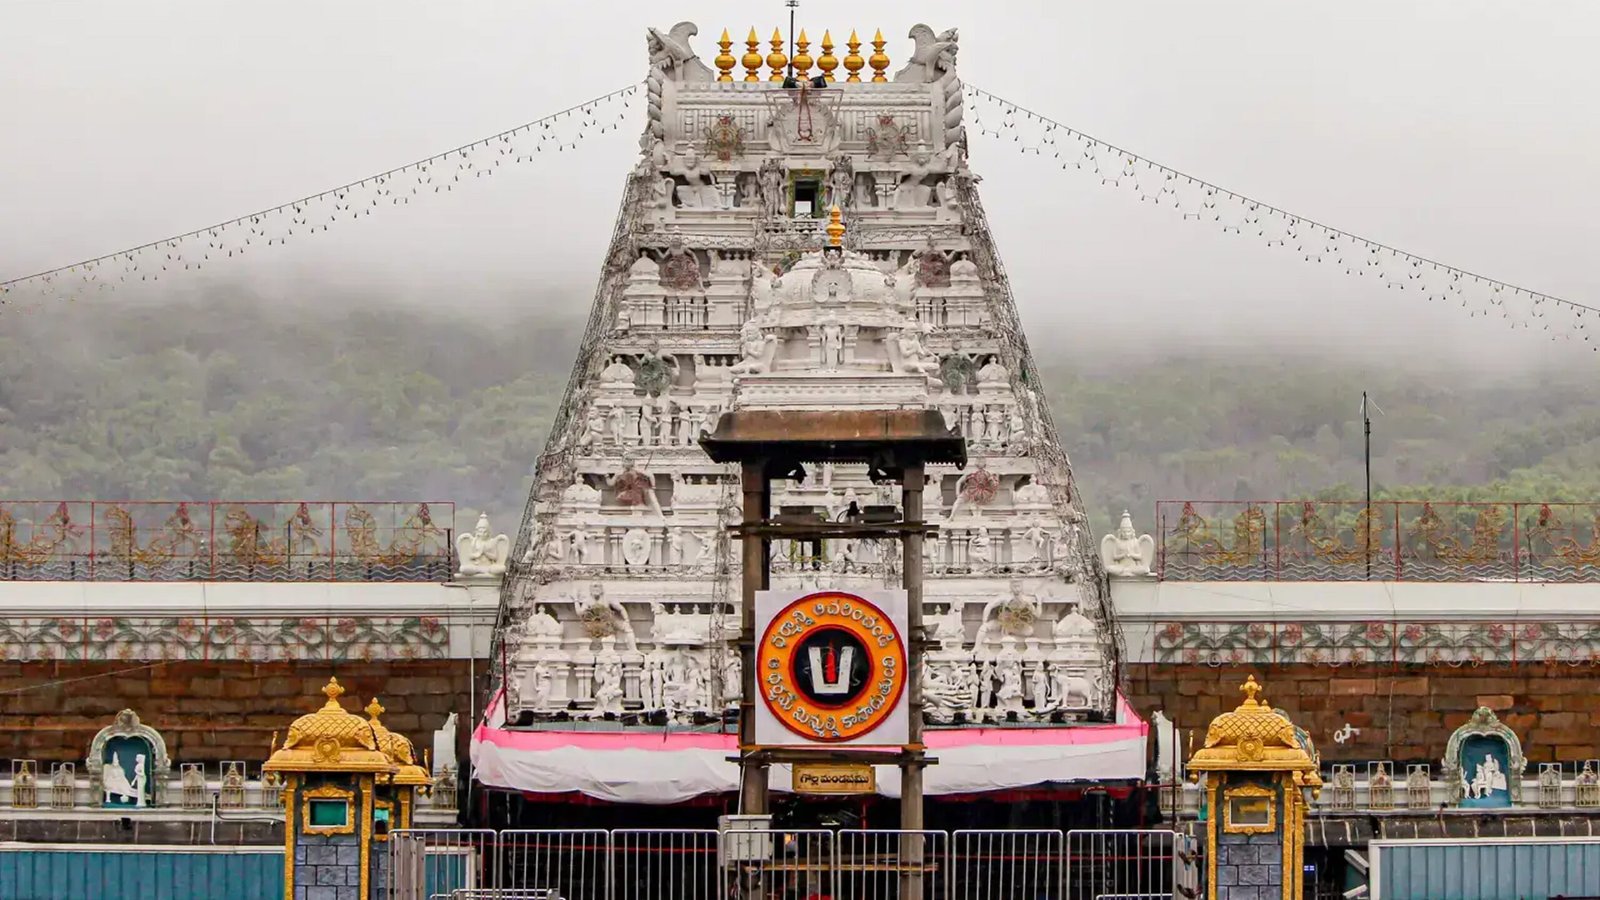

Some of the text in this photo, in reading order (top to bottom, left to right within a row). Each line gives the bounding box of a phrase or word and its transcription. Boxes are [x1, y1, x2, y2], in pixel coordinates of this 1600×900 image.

[813, 599, 895, 647] ఆచరించండి
[767, 673, 797, 710] ధర్మమే
[841, 656, 895, 728] కాపాడుతుంది
